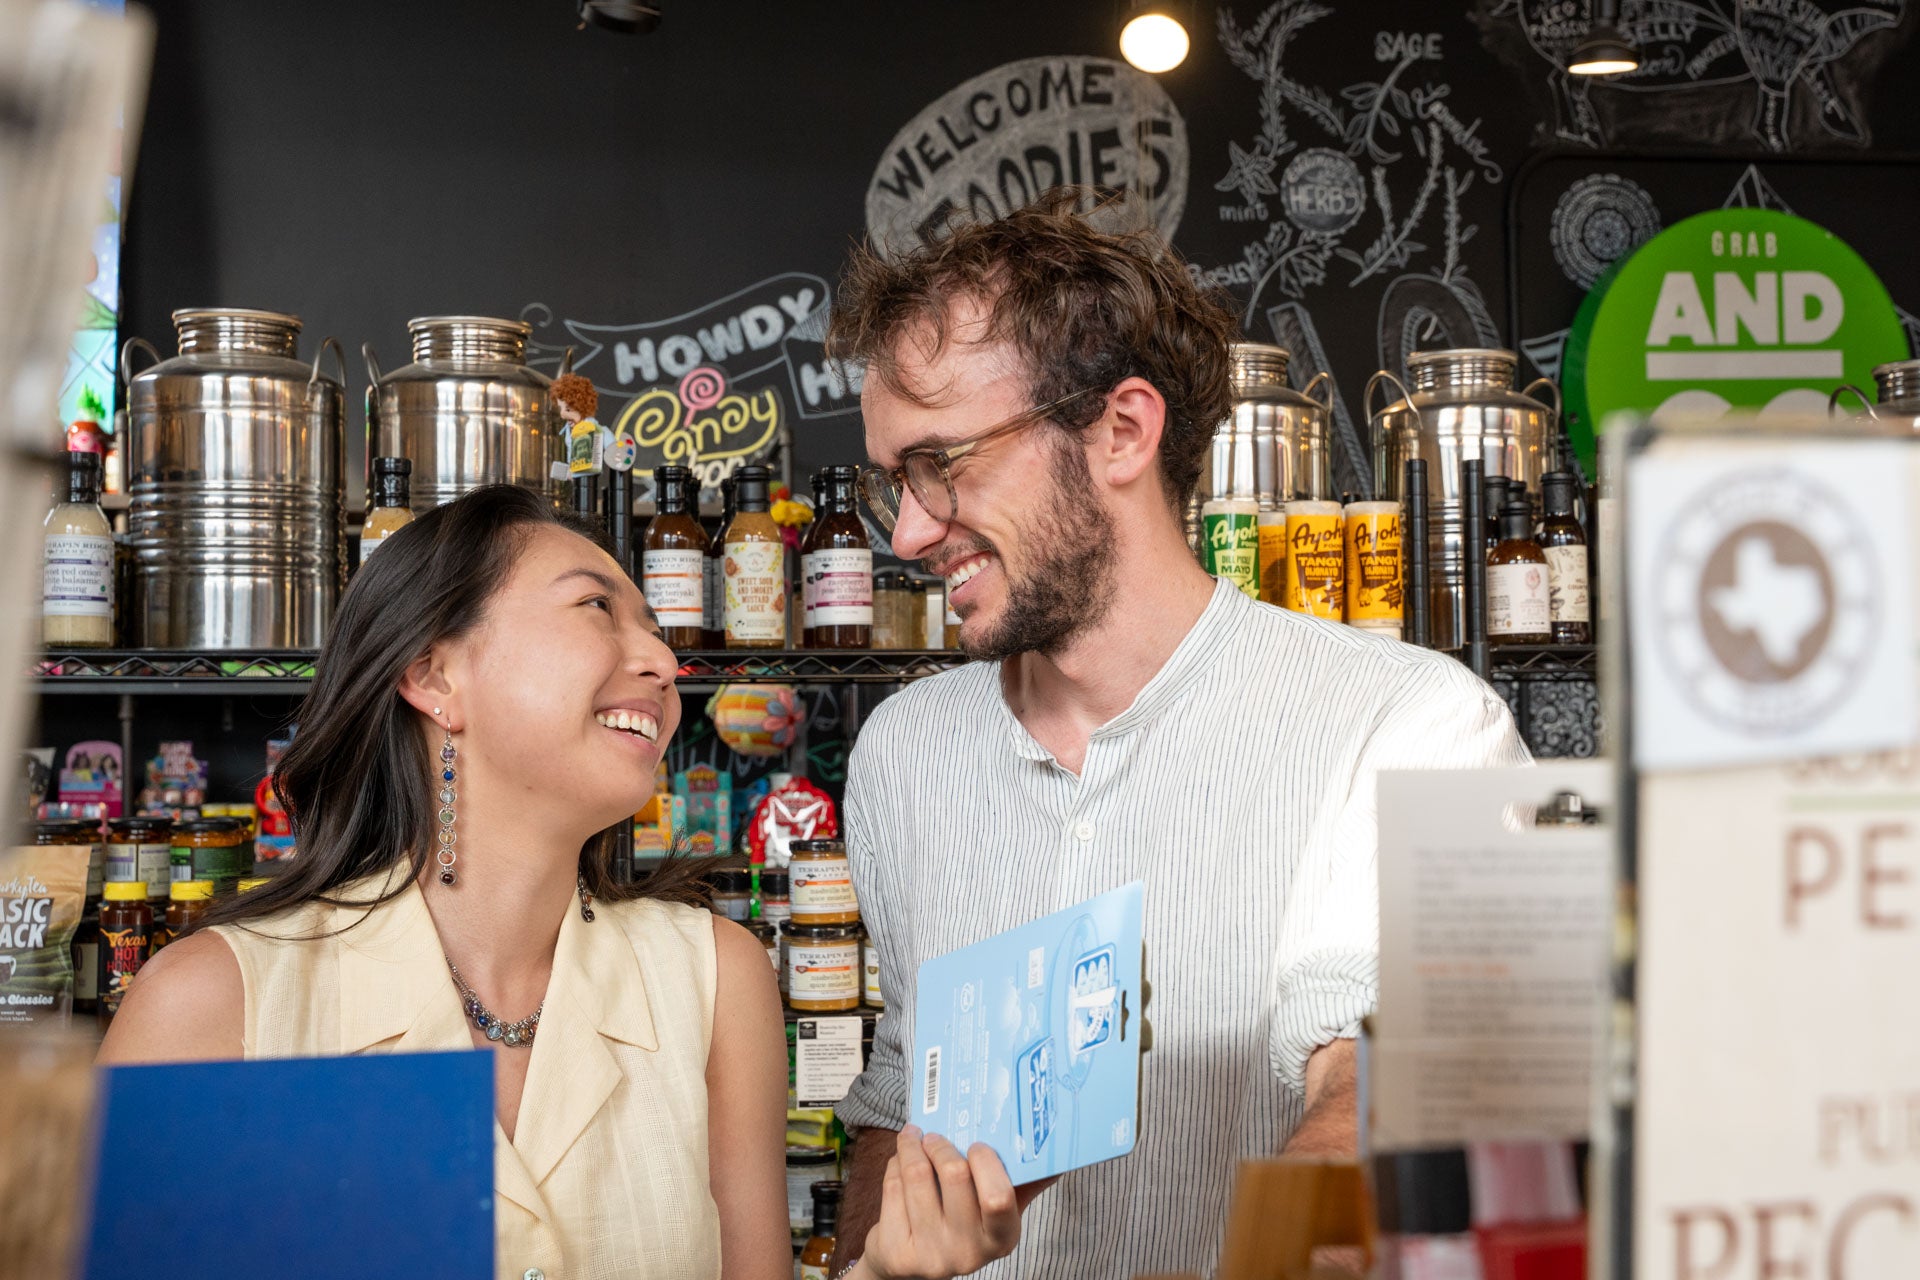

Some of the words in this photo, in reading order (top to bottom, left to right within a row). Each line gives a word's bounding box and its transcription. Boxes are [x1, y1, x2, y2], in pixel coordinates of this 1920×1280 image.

[1375, 31, 1444, 61] SAGE
[878, 62, 1115, 201] WELCOME
[1711, 231, 1777, 258] GRAB
[1645, 271, 1844, 346] AND
[613, 287, 815, 385] HOWDY
[613, 389, 779, 477] Candy
[1221, 565, 1250, 575] MAYO
[1298, 556, 1341, 567] TANGY
[1361, 556, 1397, 566] TANGY
[114, 947, 139, 961] HOT
[8, 993, 54, 1006] Classics
